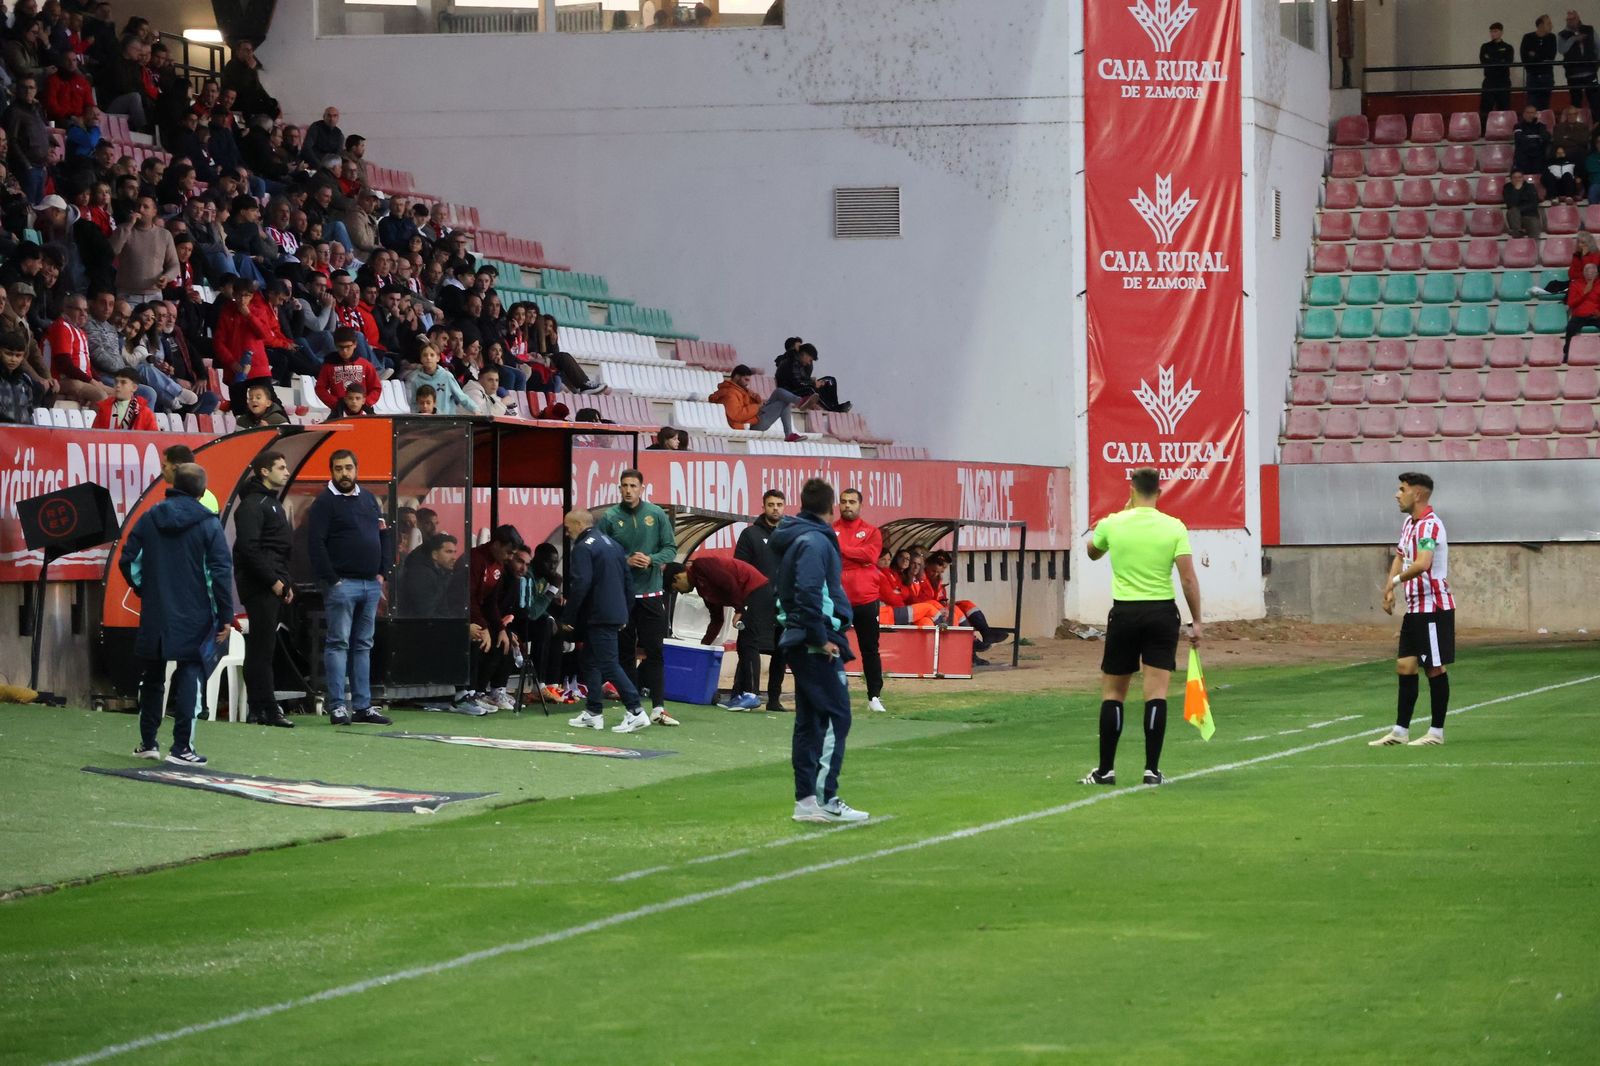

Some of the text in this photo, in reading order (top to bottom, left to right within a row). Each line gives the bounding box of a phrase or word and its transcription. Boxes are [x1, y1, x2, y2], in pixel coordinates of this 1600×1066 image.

[1098, 58, 1228, 82] CAJA RURAL
[1121, 86, 1205, 99] DE ZAMORA
[1100, 250, 1229, 273] CAJA RURAL
[1123, 277, 1207, 290] DE ZAMORA
[1102, 441, 1230, 464] CAJA RURAL
[761, 461, 840, 506] FABRICÓN
[869, 470, 903, 507] STAND
[1153, 468, 1209, 480] AMORA
